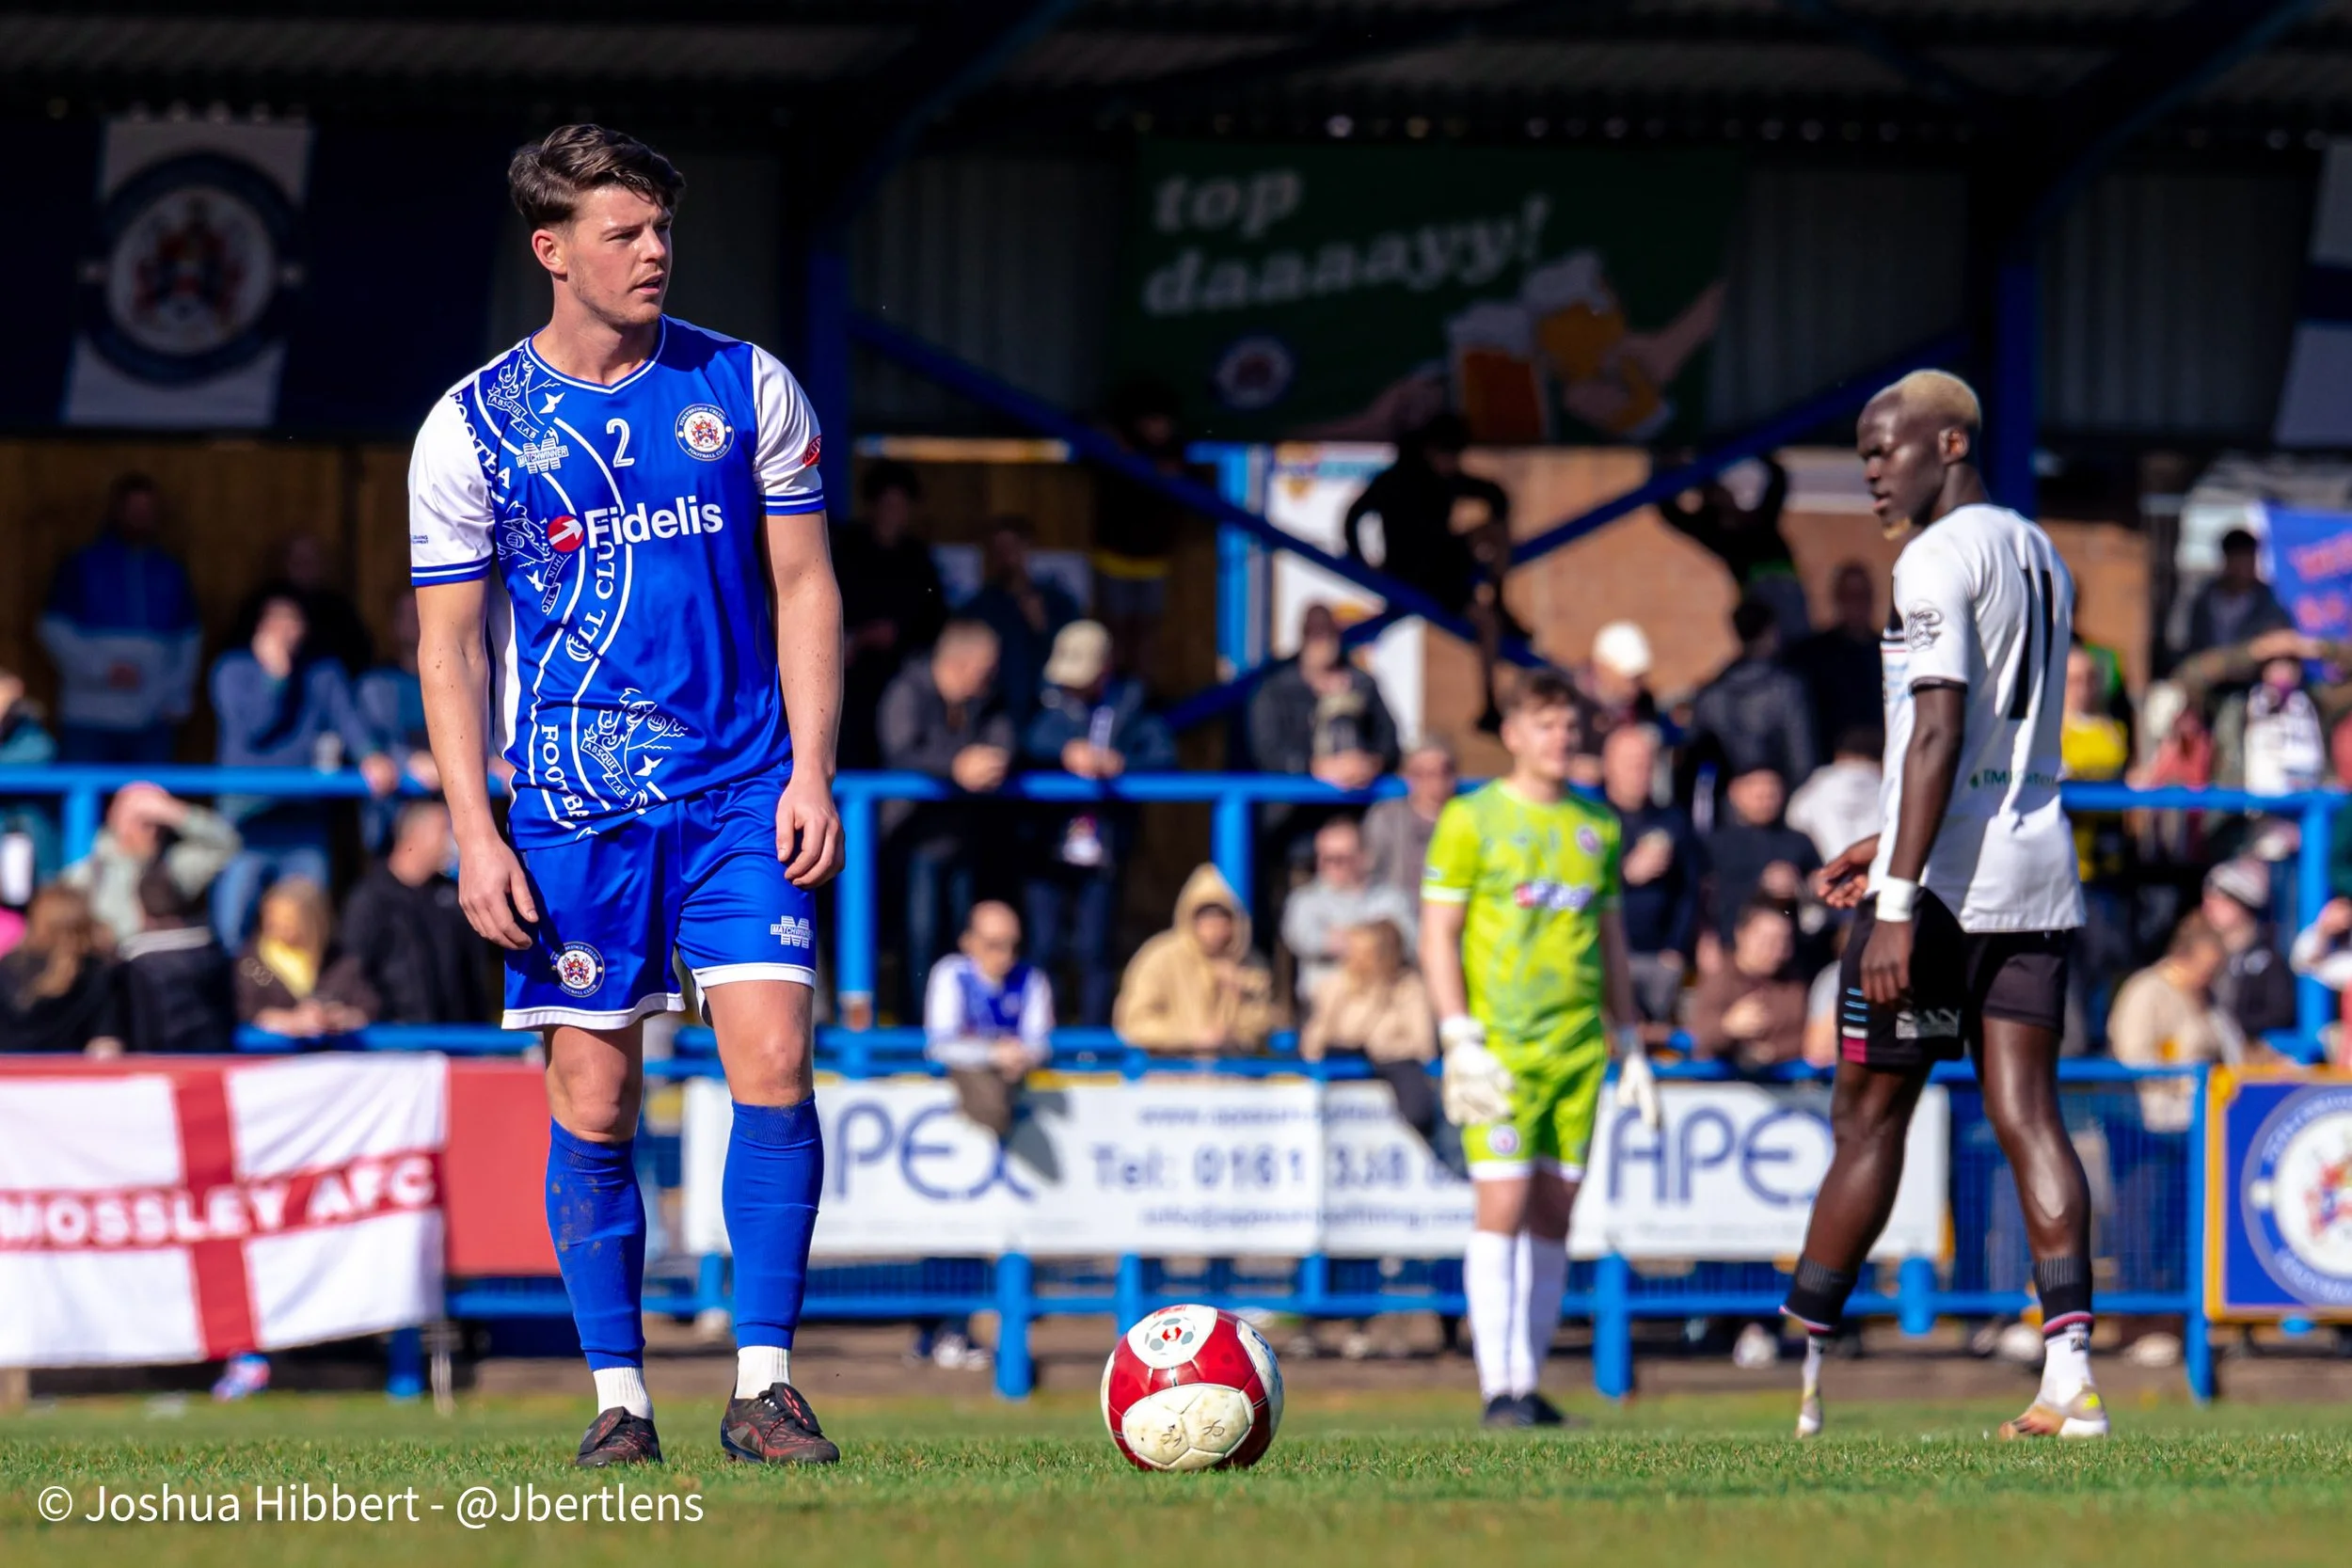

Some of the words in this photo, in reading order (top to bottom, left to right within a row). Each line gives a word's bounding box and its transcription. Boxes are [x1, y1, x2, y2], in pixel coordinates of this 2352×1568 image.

[1153, 170, 1300, 237] top
[1142, 194, 1550, 316] daaaayy!
[518, 422, 538, 439] LAB
[606, 418, 635, 467] 2
[516, 446, 567, 467] MATCHWINNER
[584, 495, 723, 549] Fidelis
[583, 741, 618, 771] ABSQUE
[610, 780, 628, 797] LAB
[1605, 1104, 1836, 1206] APE
[0, 1183, 284, 1246] MOSSLEY
[310, 1157, 435, 1223] AFC
